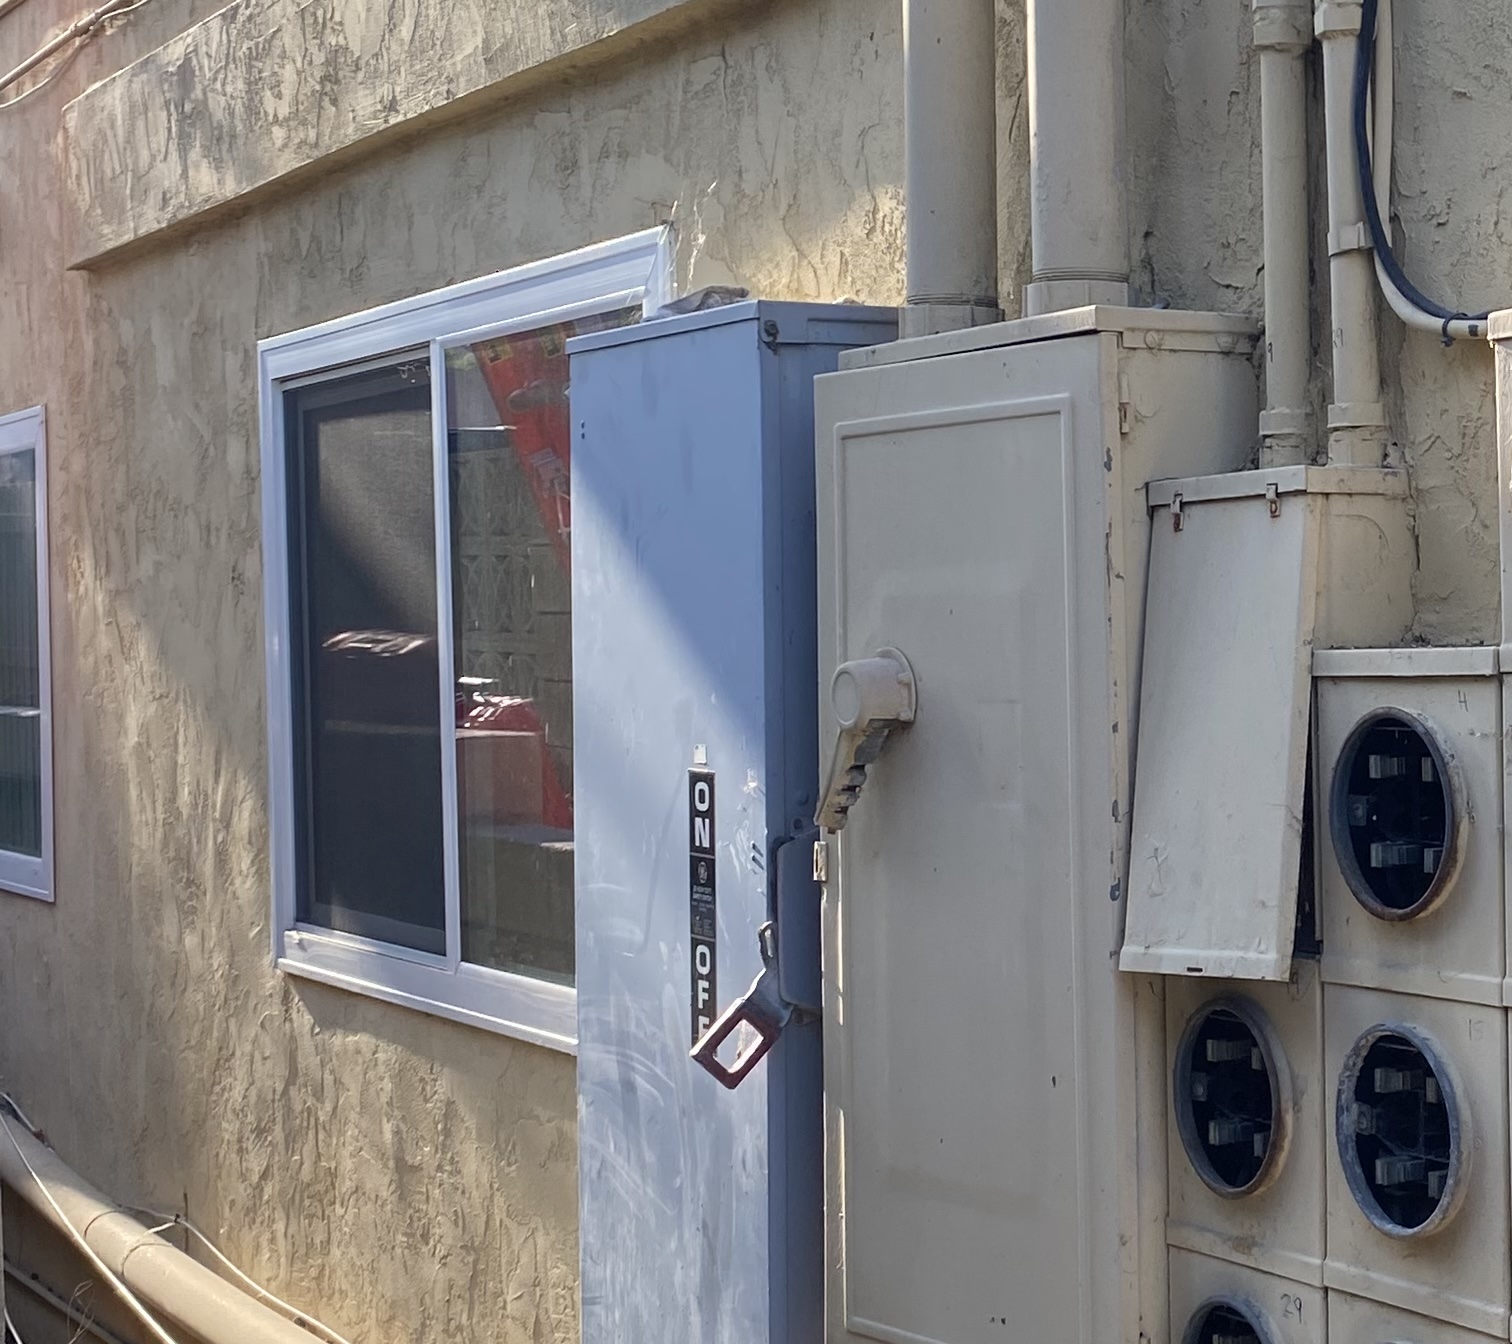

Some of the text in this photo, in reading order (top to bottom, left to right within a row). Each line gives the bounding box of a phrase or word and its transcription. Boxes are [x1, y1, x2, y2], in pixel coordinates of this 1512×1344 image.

[694, 781, 710, 848] ON
[695, 944, 711, 1042] OFF
[1280, 1293, 1302, 1324] 29
